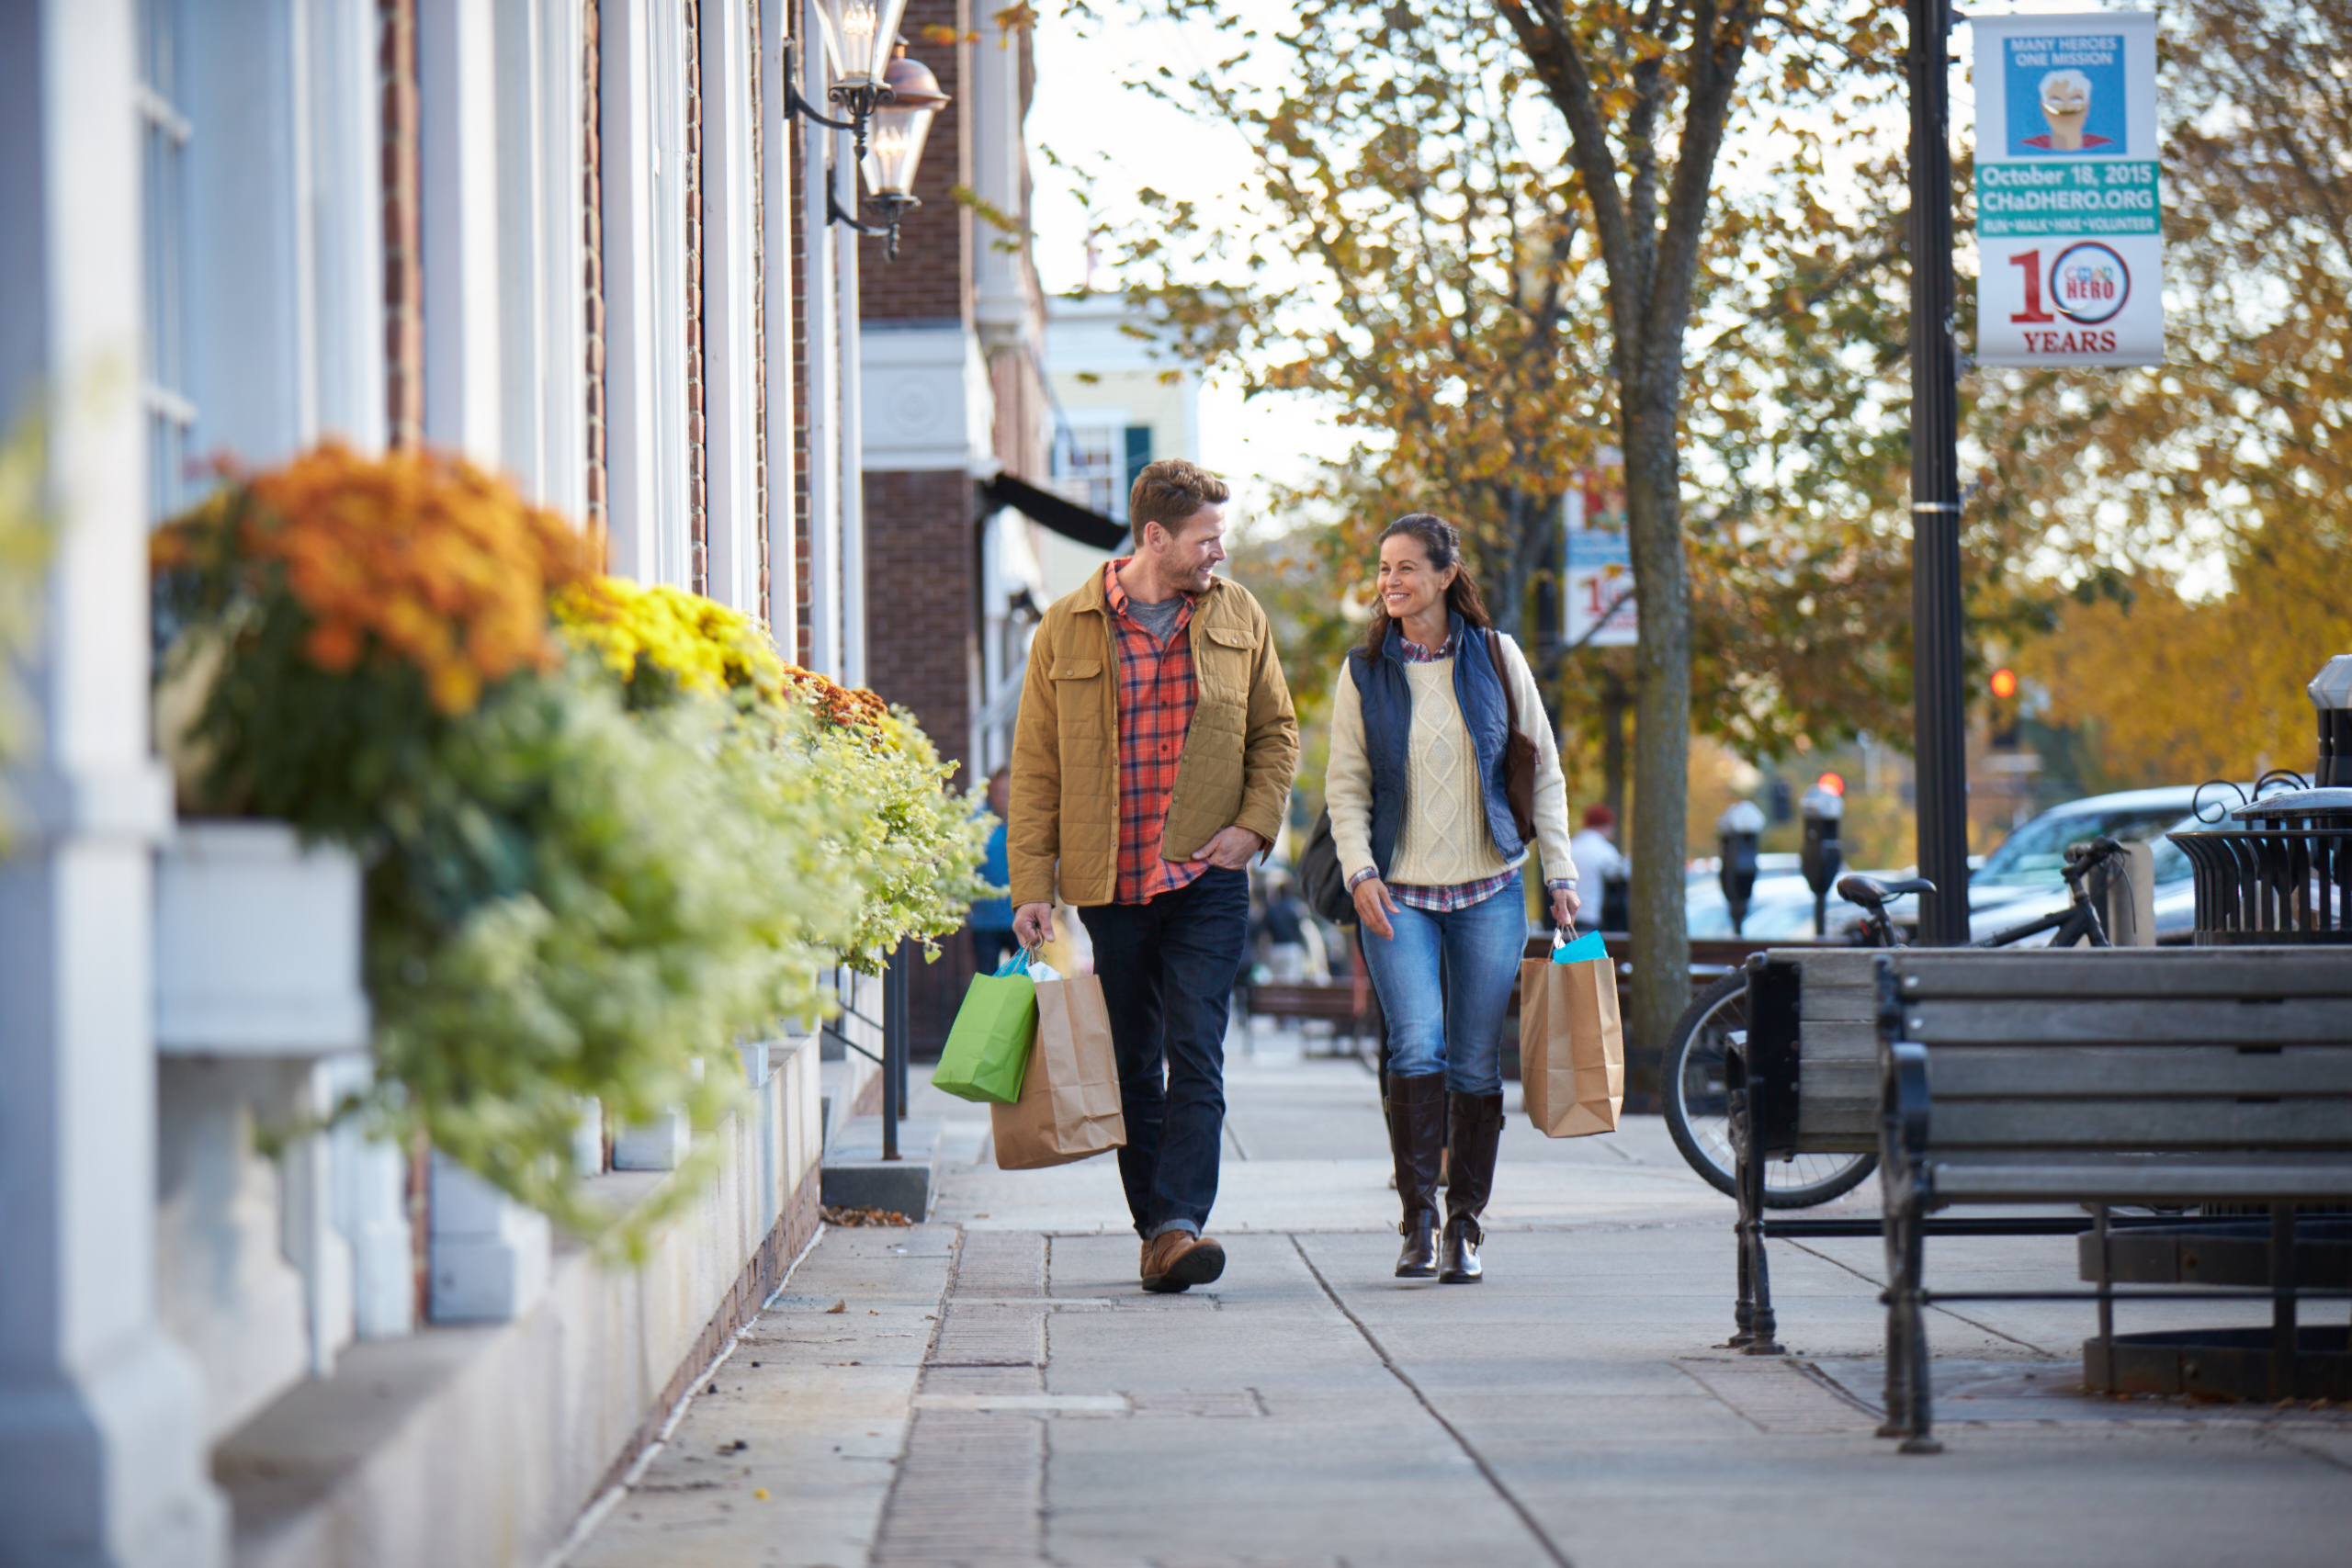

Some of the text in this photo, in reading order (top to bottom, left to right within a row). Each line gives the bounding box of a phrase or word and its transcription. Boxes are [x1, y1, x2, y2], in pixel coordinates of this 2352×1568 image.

[2012, 37, 2116, 51] MANY HEROES
[2016, 52, 2112, 66] ONE MISSION
[1983, 164, 2153, 186] October 18, 2015
[1983, 190, 2154, 211] CHaDHERO.ORG
[2066, 281, 2115, 299] HERO
[2023, 331, 2116, 353] YEARS
